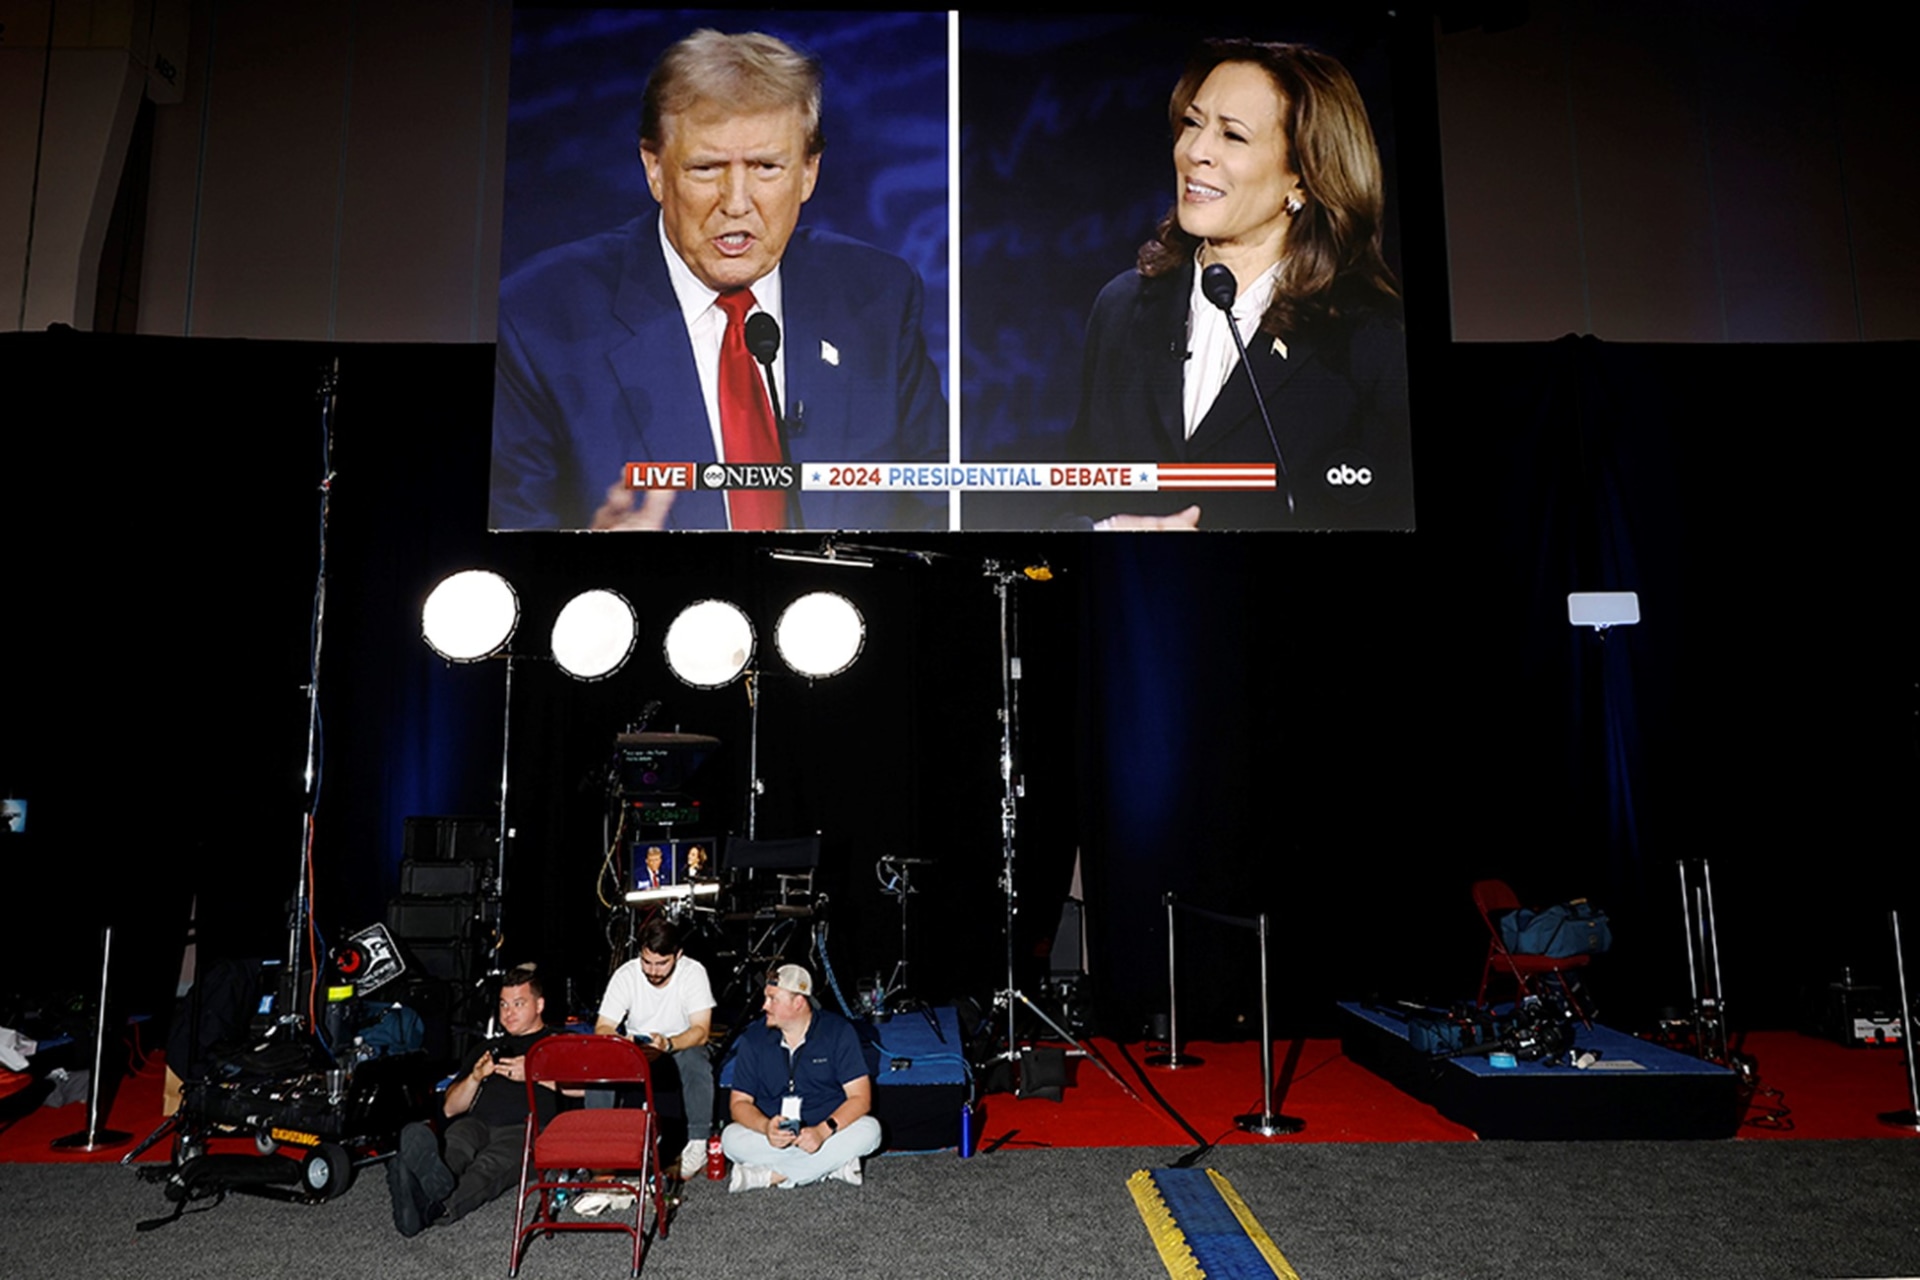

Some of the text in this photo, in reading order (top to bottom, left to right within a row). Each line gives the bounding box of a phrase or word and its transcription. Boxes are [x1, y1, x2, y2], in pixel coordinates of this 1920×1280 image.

[632, 467, 687, 487] LIVE
[725, 466, 793, 487] NEWS
[828, 467, 1132, 486] 2024 PRESIDENTIAL DEBATE
[1326, 464, 1373, 485] abc
